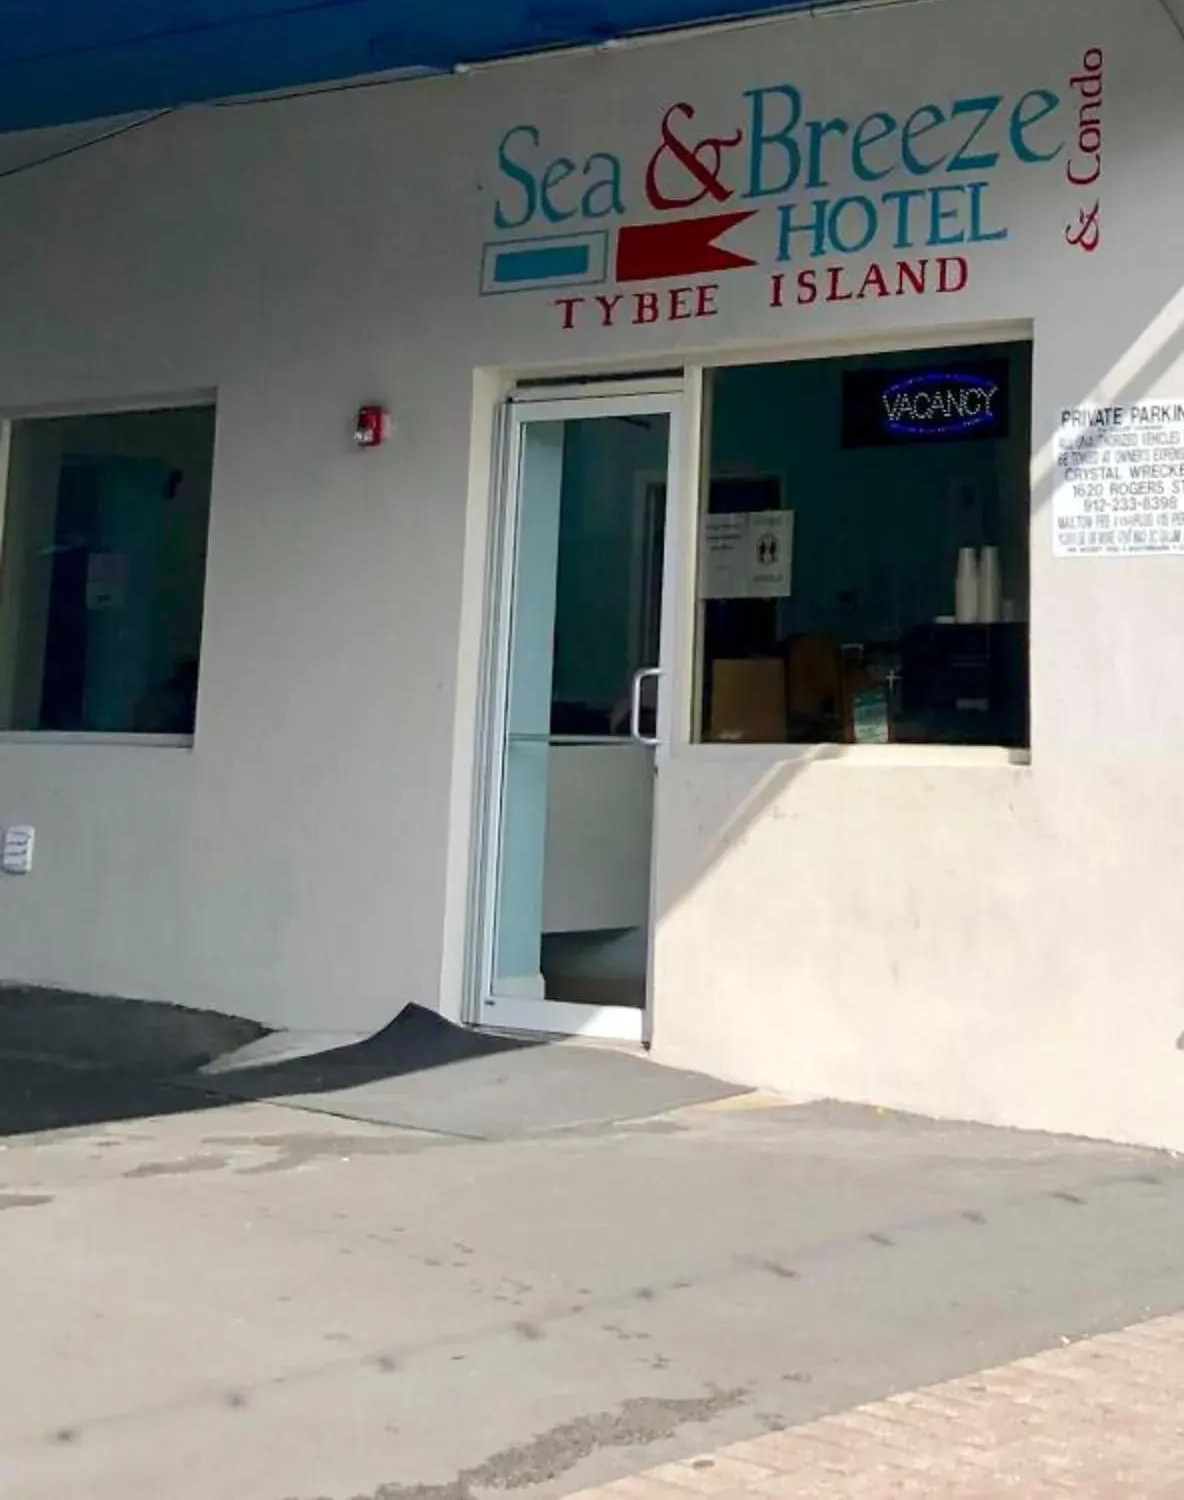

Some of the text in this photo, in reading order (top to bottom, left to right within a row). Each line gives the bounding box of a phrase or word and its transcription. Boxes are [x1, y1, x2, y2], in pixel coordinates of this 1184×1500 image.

[493, 84, 1064, 230] Sea & Breeze
[1065, 46, 1104, 253] & Condo
[776, 181, 1008, 261] HOTEL
[555, 256, 969, 330] TYBEE ISLAND
[882, 386, 998, 421] VACANCY
[1061, 407, 1124, 427] PRIVATE
[1064, 466, 1122, 482] CRYSTAL
[1072, 484, 1104, 498] 1620
[1109, 481, 1165, 496] ROGERS
